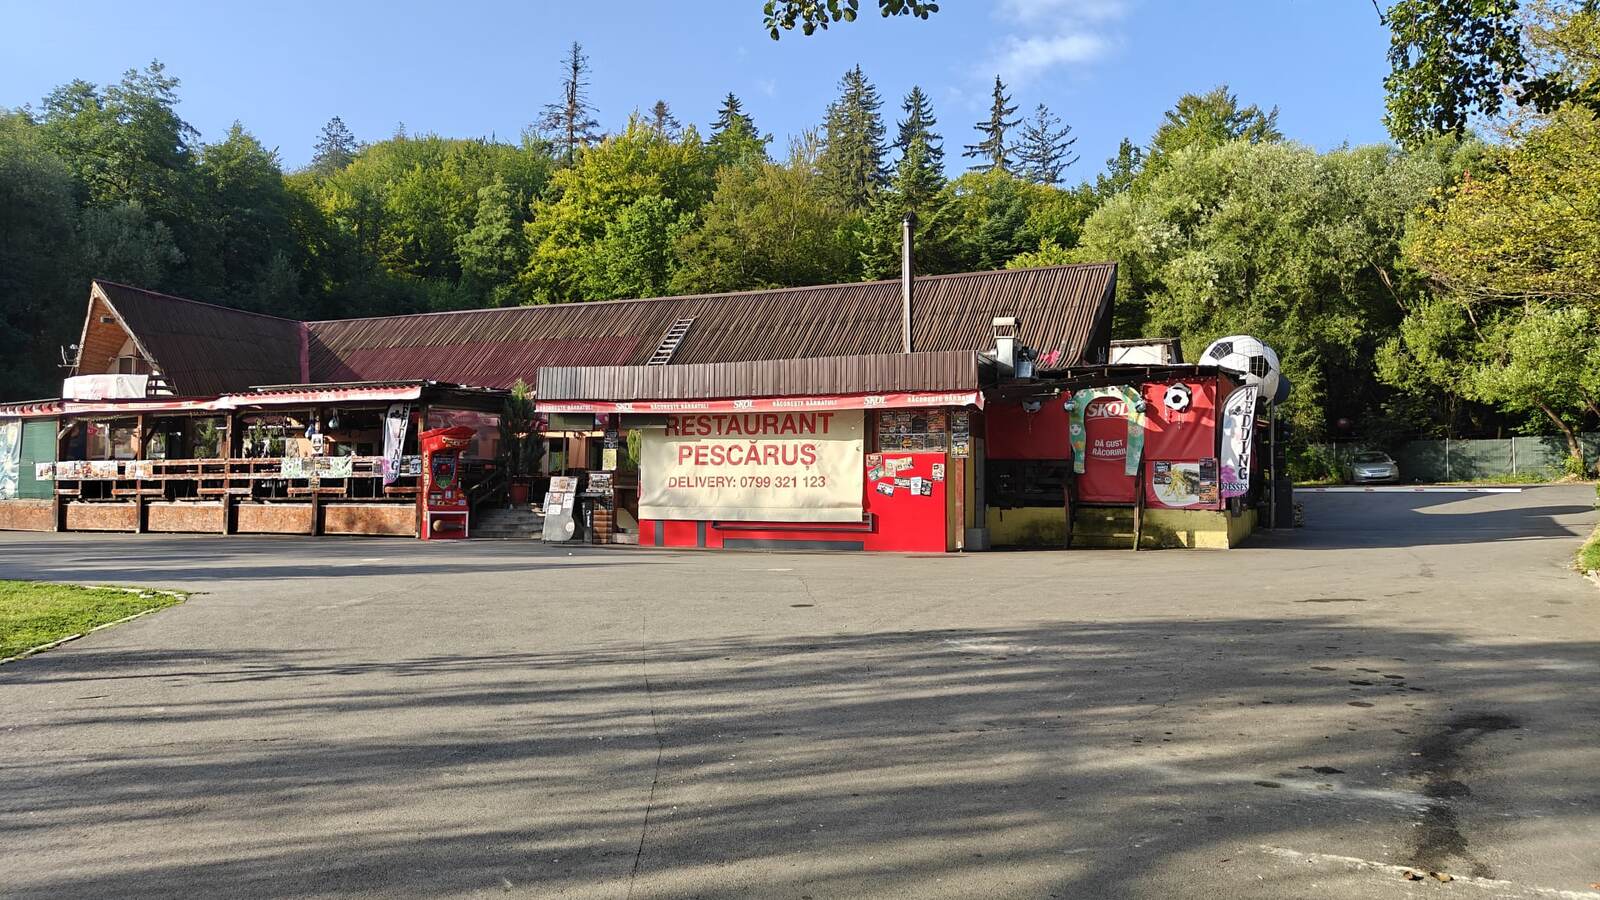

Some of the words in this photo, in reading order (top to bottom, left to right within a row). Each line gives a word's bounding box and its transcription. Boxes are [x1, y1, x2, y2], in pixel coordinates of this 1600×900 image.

[615, 402, 633, 411] SKOL
[733, 399, 754, 409] SKOL
[863, 396, 886, 406] SKOL
[1087, 401, 1129, 418] SKOL
[665, 412, 834, 436] RESTAURANT
[1238, 388, 1253, 480] WEDDING
[1105, 440, 1123, 448] GUST
[678, 440, 817, 470] PESCĂRUȘ
[668, 476, 736, 488] DELIVERY:
[740, 476, 771, 488] 0799
[775, 476, 798, 488] 321
[803, 475, 826, 488] 123
